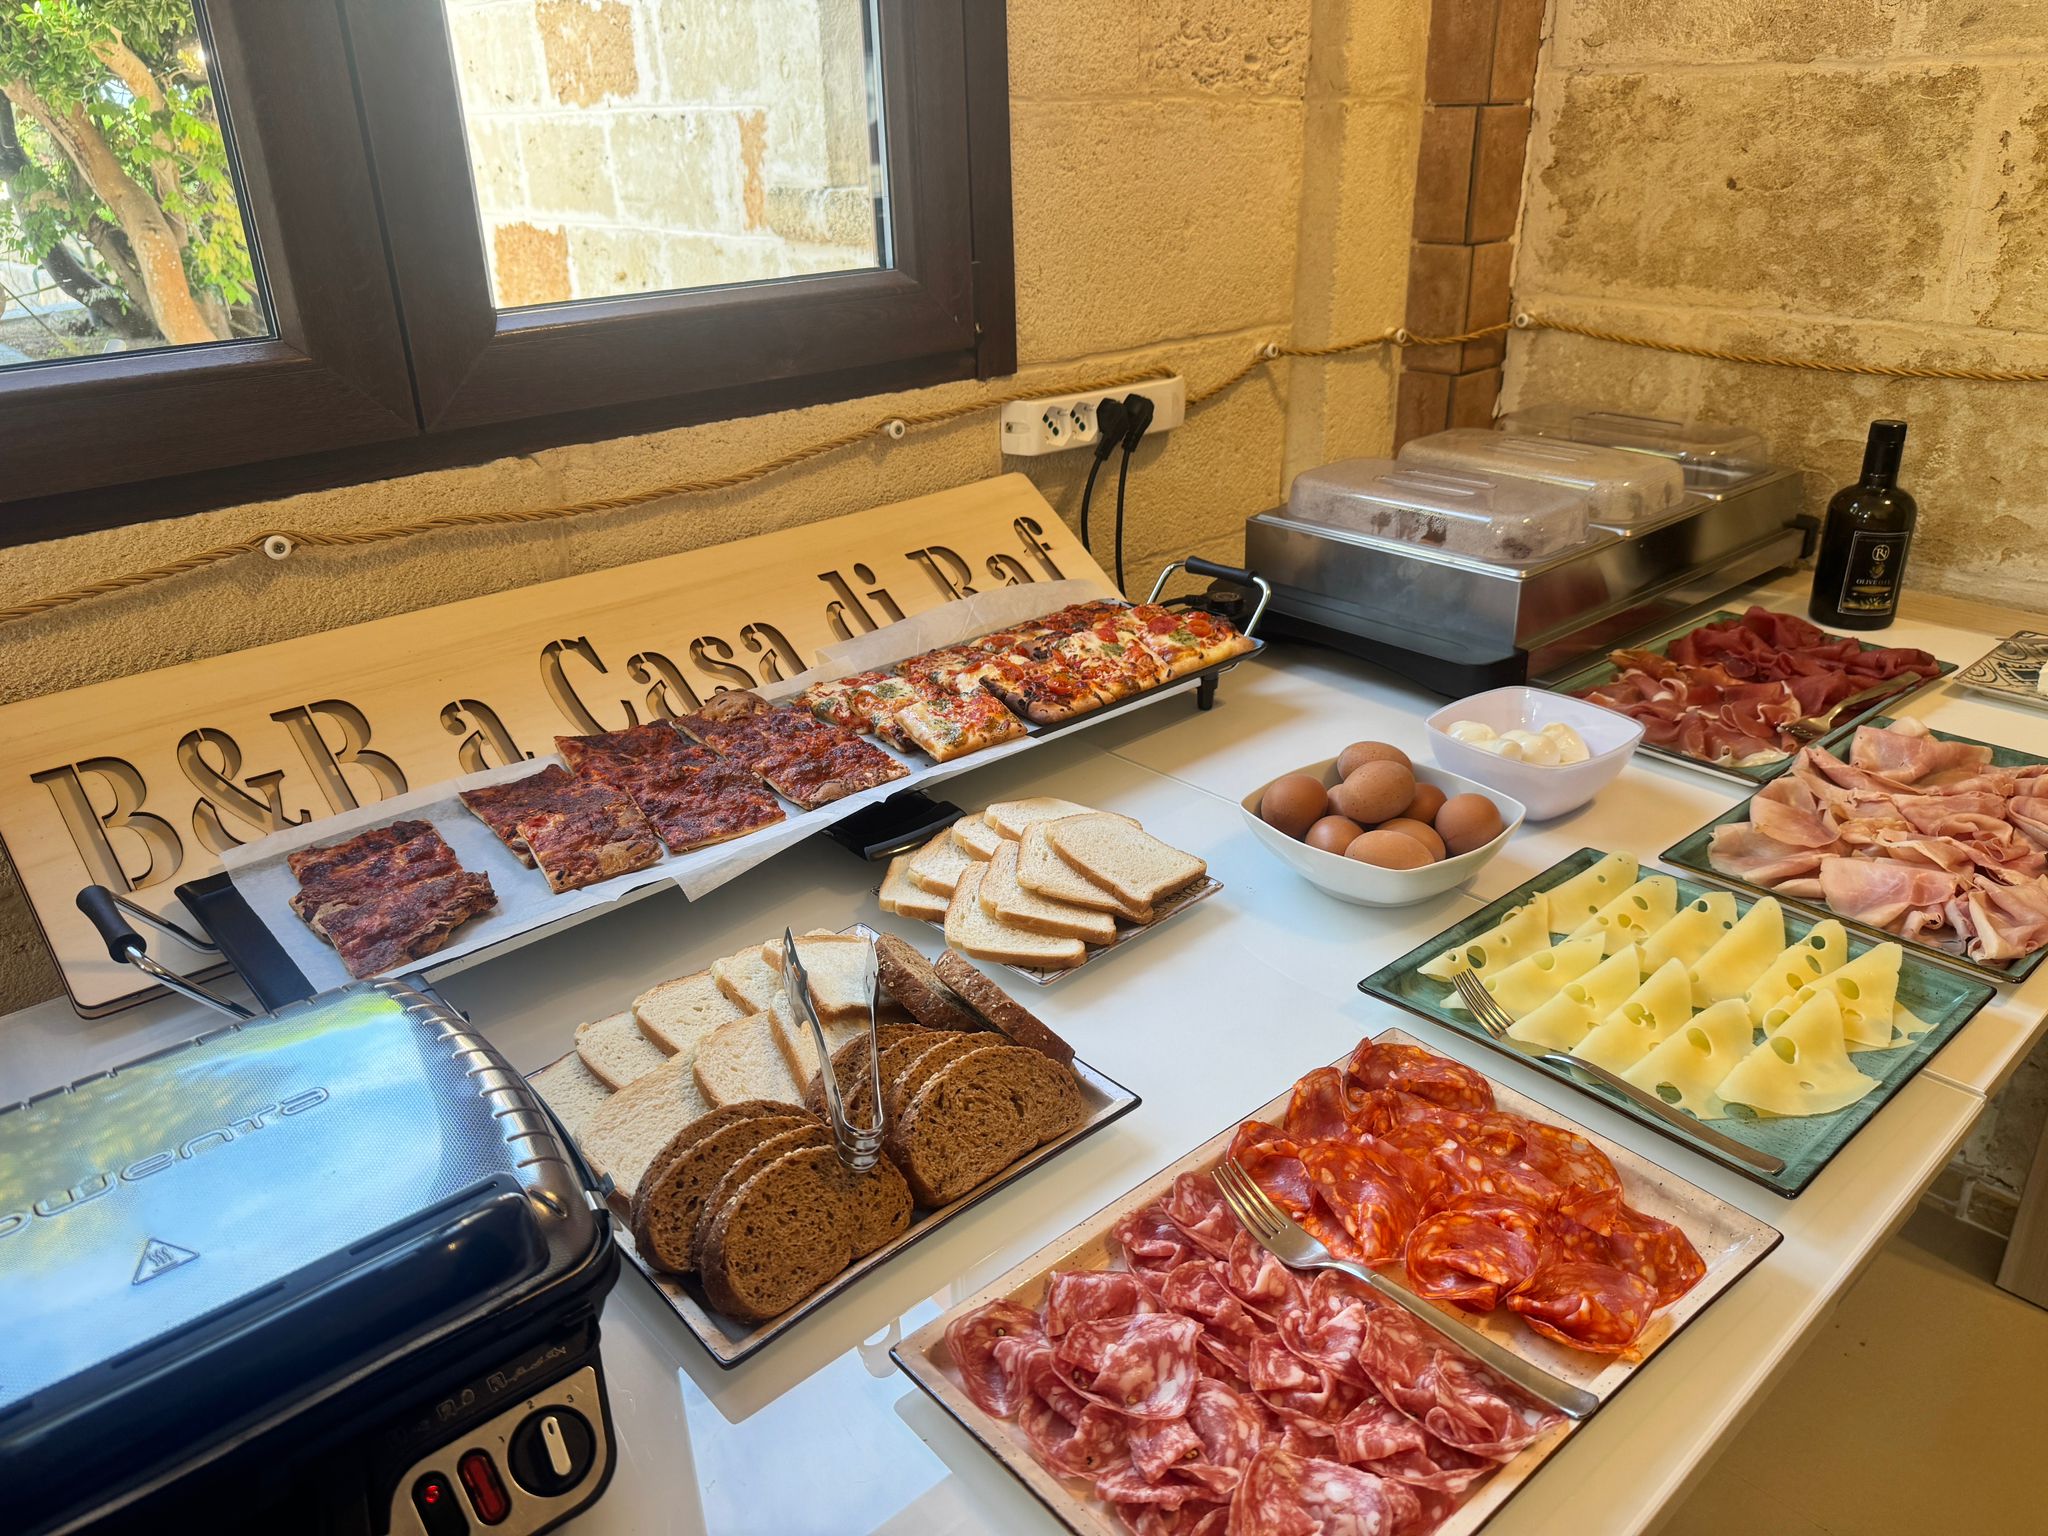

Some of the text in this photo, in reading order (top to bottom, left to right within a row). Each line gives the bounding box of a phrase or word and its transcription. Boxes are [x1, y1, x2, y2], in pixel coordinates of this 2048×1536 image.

[29, 698, 410, 891] B&B
[439, 698, 534, 772] a
[540, 621, 808, 735] Casa
[817, 562, 906, 639] di
[566, 1393, 575, 1403] 3
[526, 1400, 535, 1409] 2
